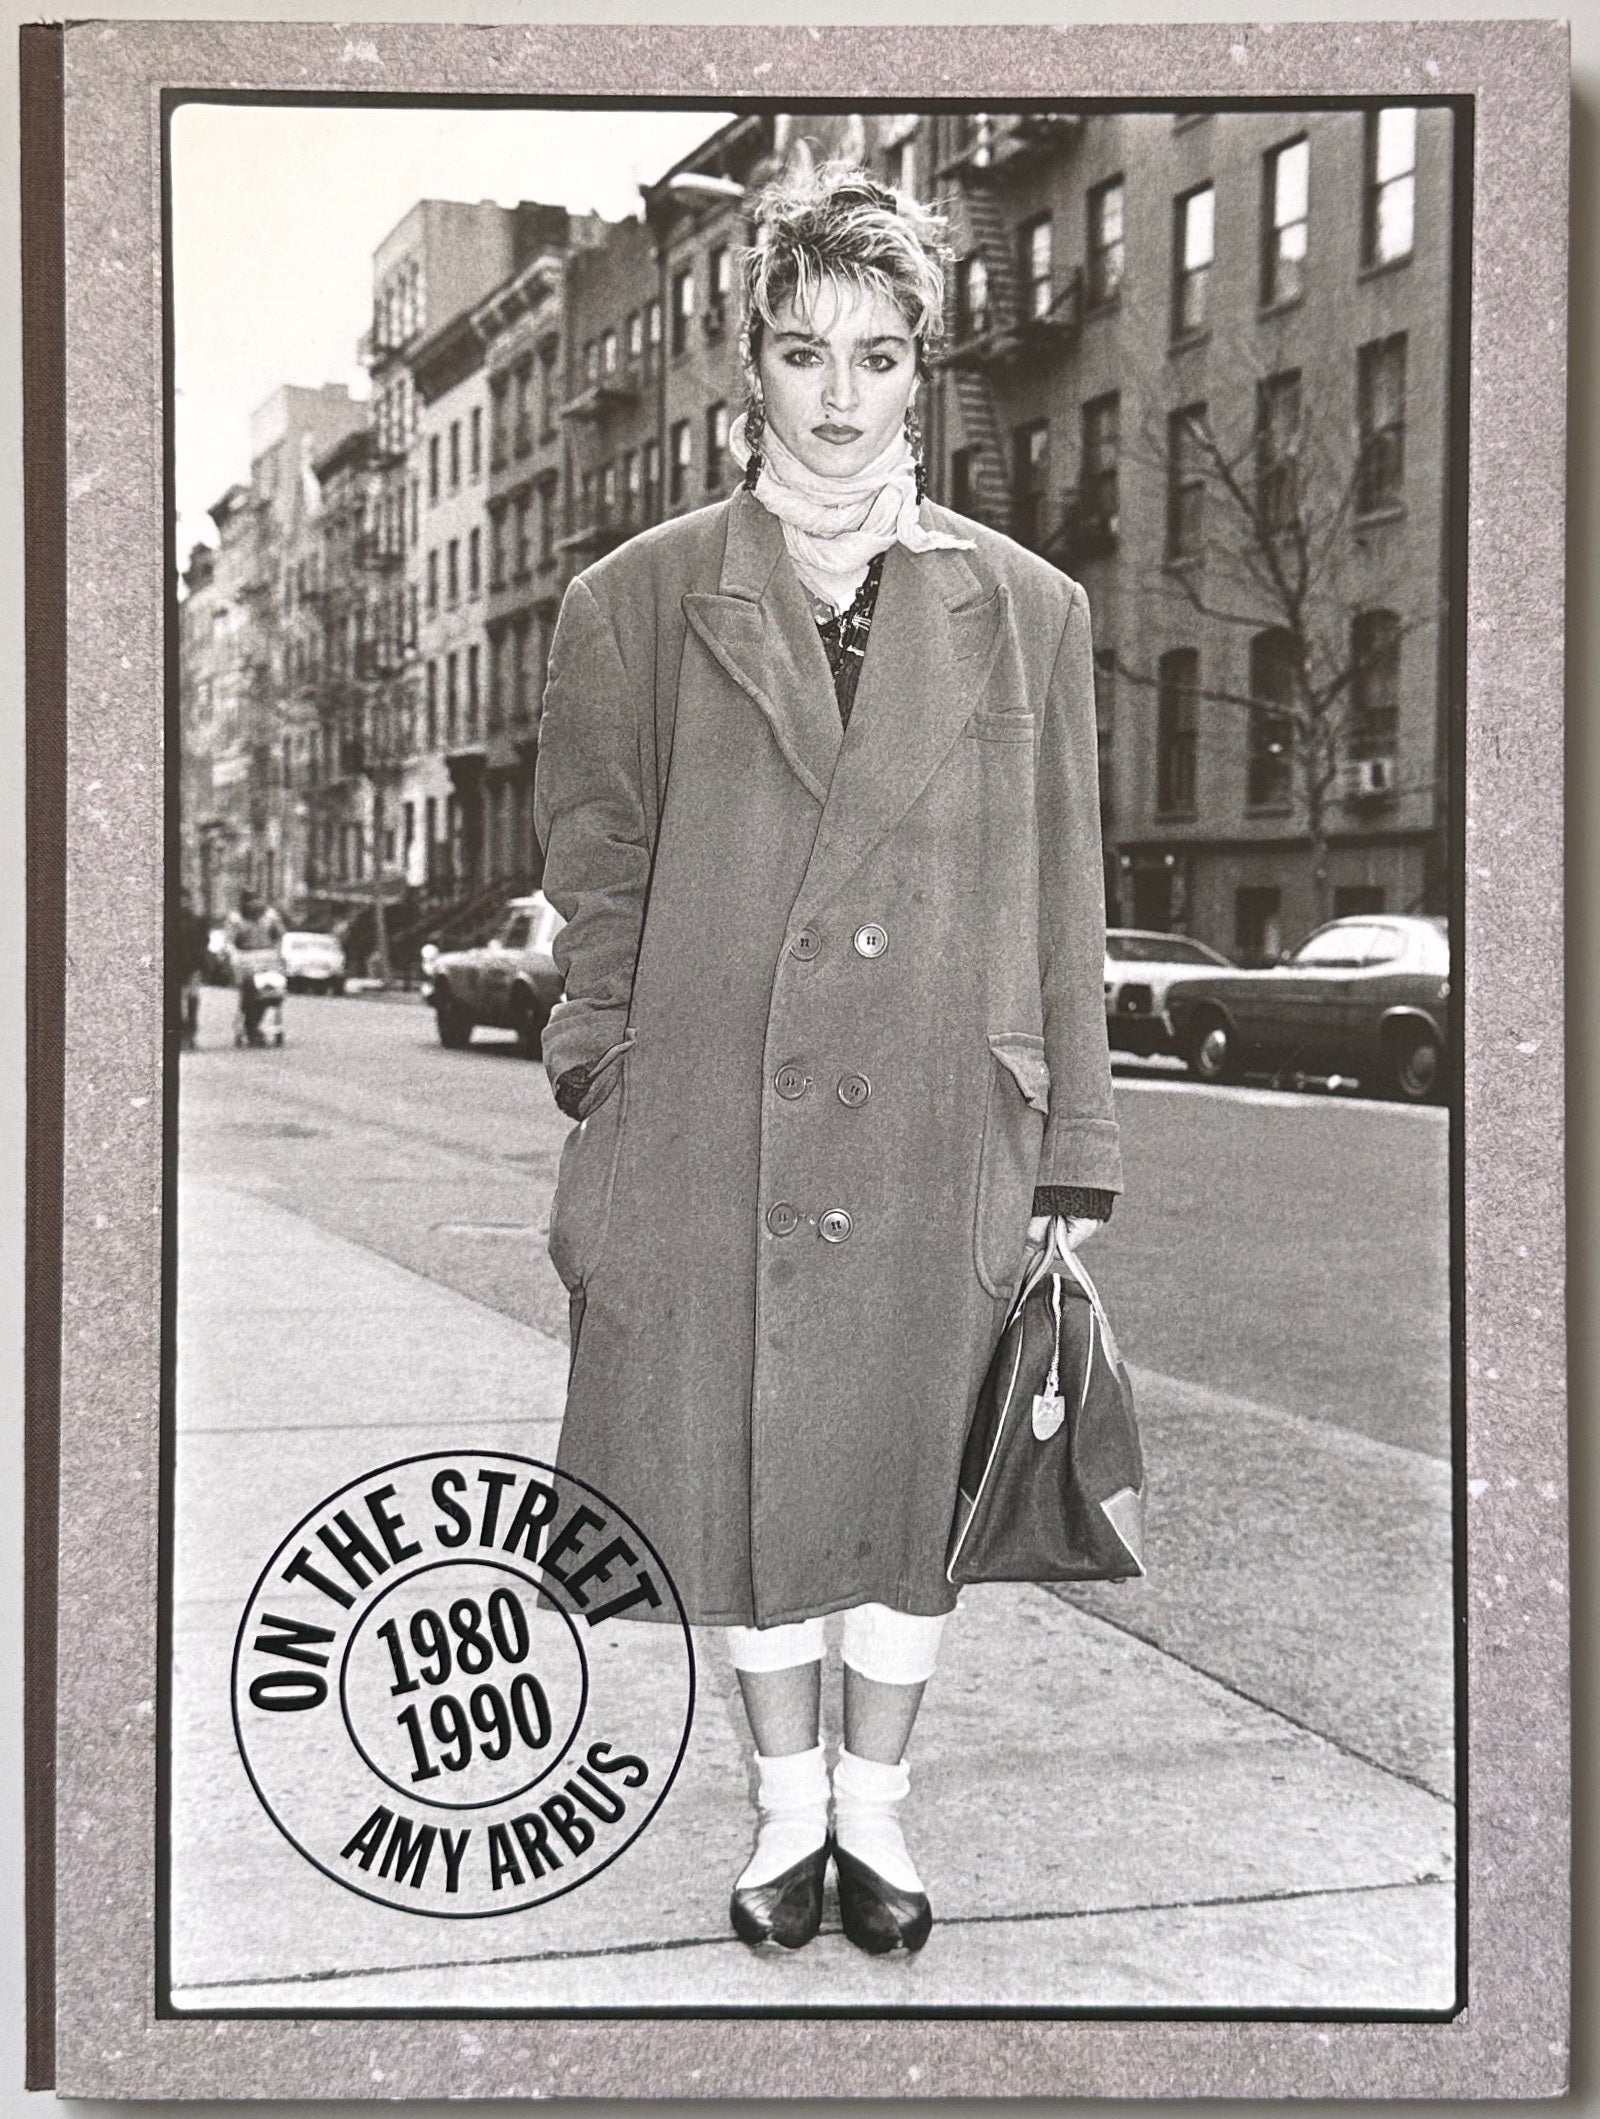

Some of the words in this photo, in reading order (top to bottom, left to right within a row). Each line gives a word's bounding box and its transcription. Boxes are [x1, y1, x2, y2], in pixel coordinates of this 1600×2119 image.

[281, 1483, 423, 1610] THE
[431, 1468, 663, 1627] STREET
[249, 1613, 336, 1712] ON
[376, 1587, 531, 1696] 1980
[397, 1673, 552, 1783] 1990
[339, 1804, 472, 1893] AMY
[487, 1741, 650, 1891] ARBUS
